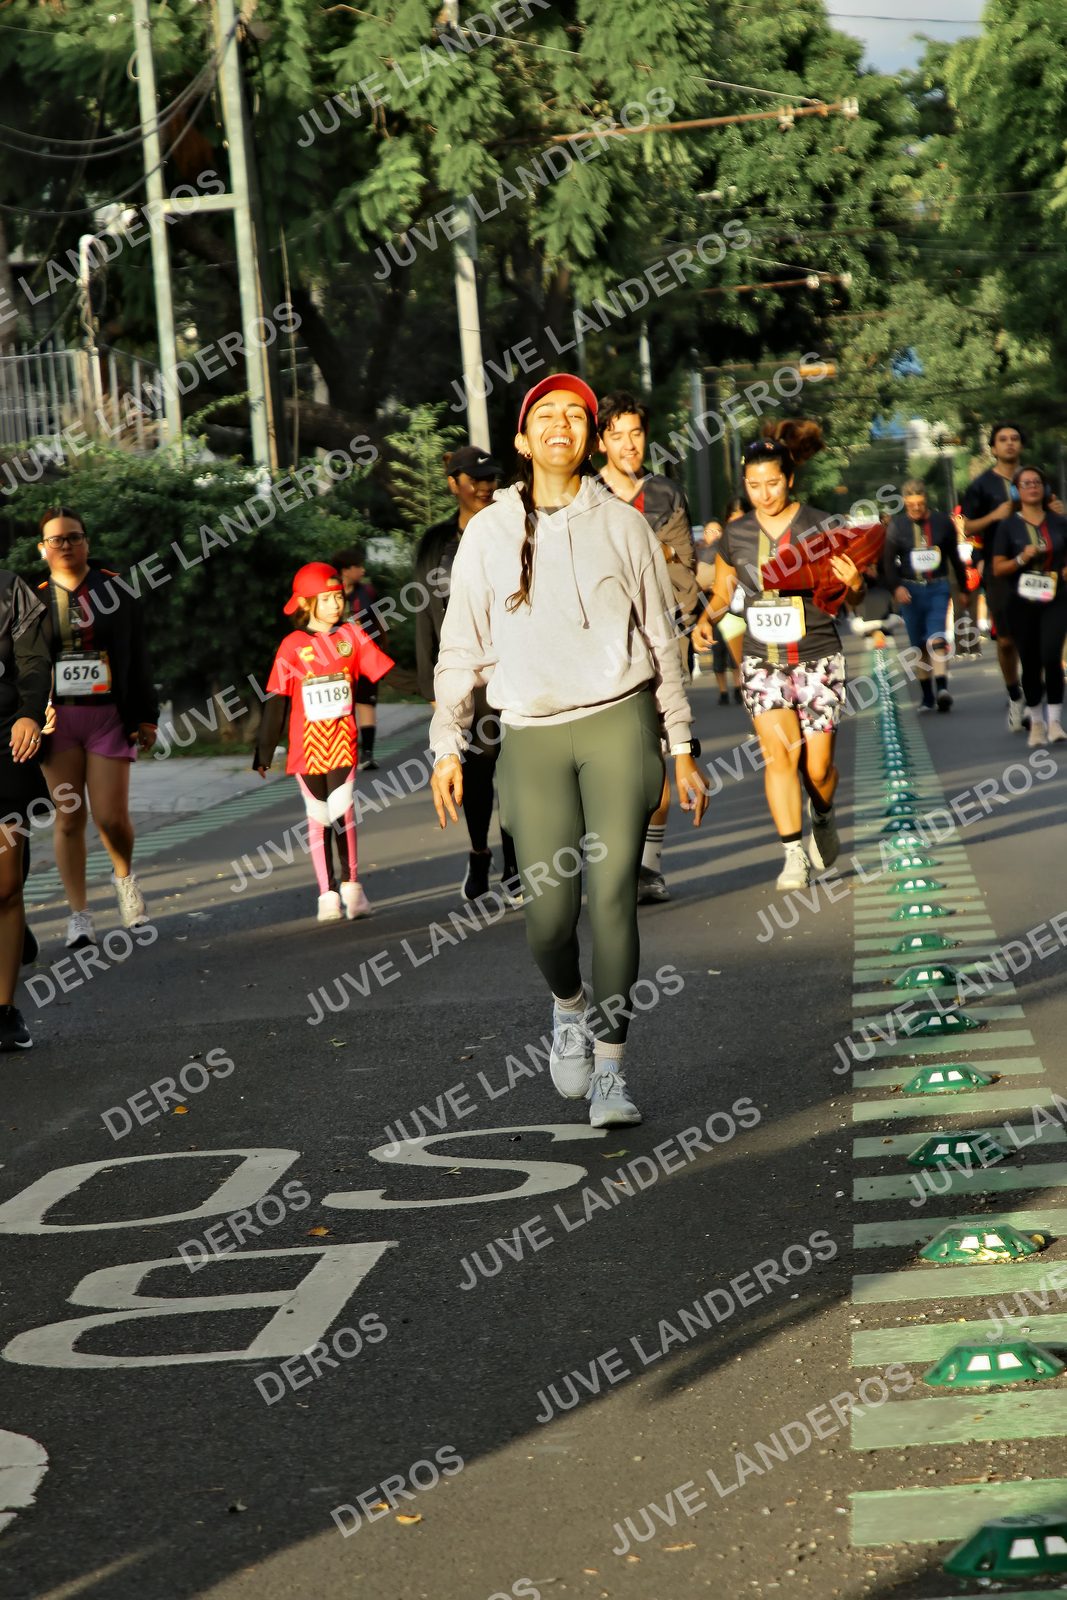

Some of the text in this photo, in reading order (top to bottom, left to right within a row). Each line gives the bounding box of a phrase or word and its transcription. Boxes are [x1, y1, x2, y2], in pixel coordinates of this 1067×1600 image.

[756, 613, 791, 627] 5307
[63, 665, 100, 681] 6576
[306, 686, 350, 705] 11189
